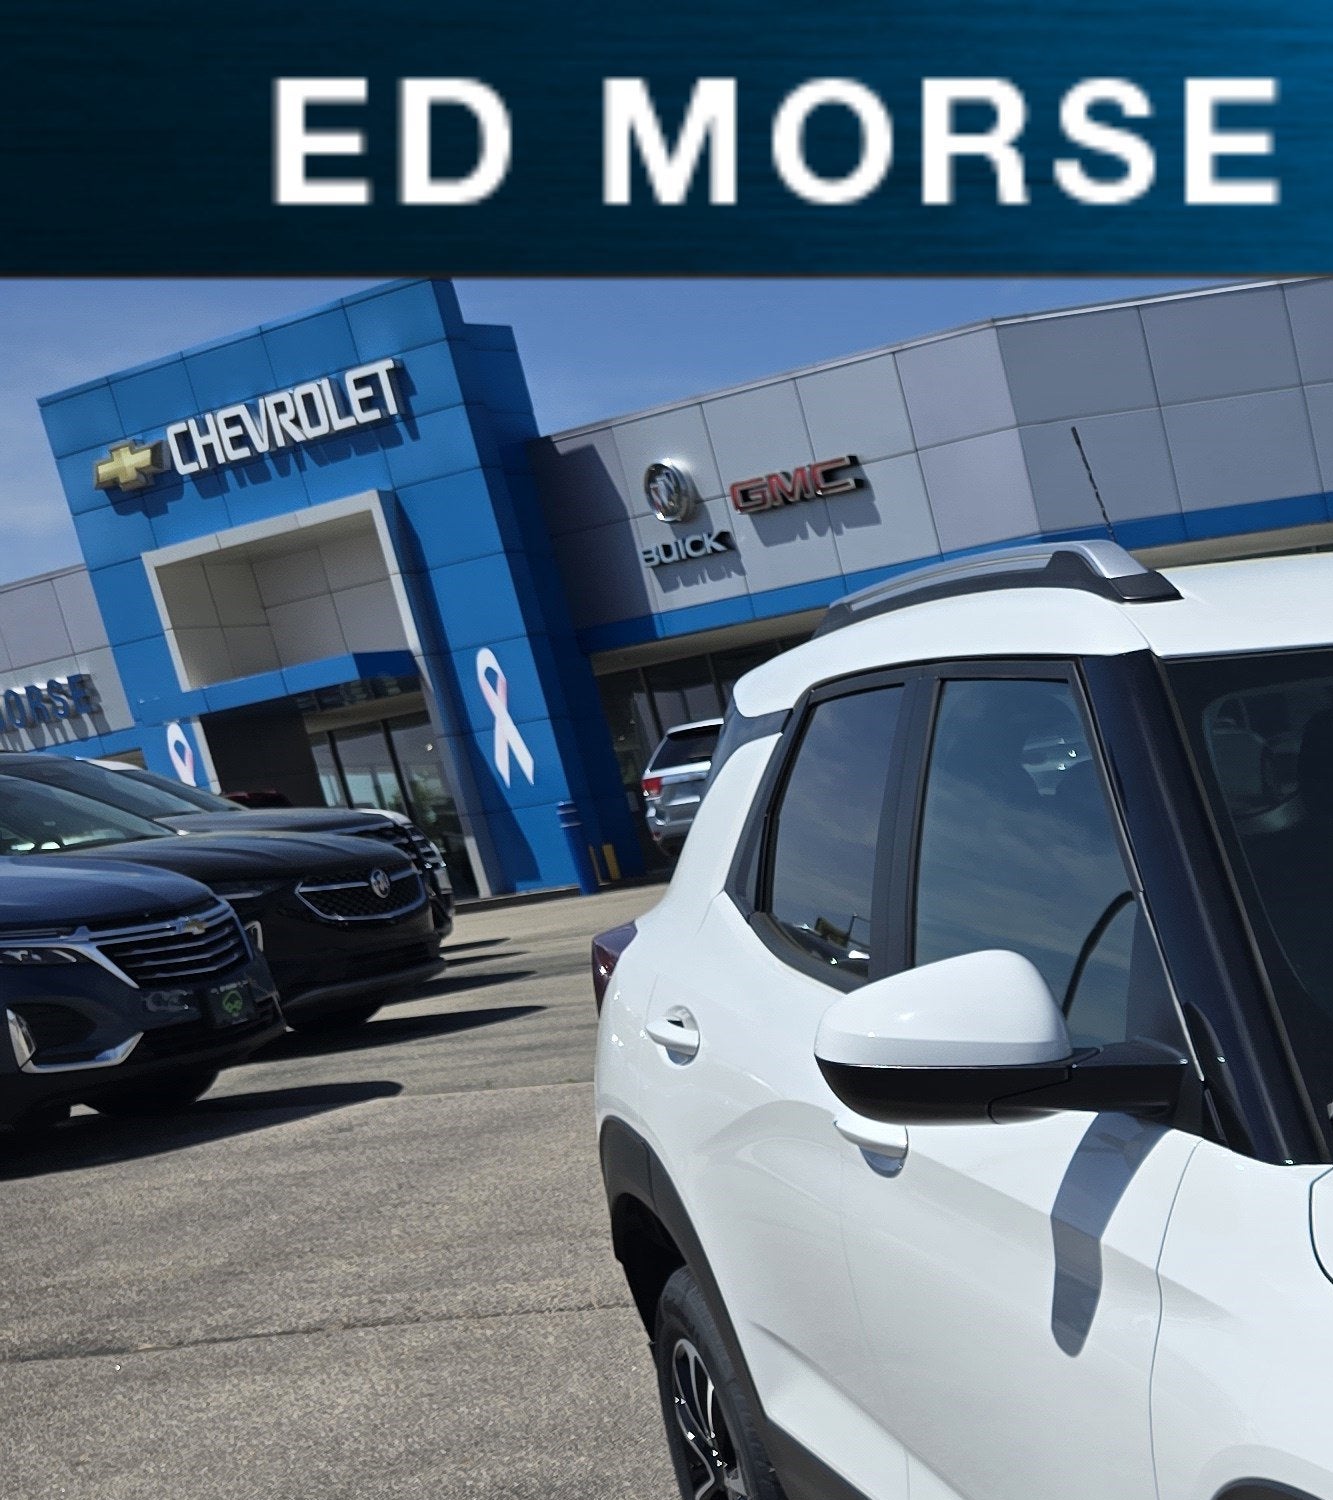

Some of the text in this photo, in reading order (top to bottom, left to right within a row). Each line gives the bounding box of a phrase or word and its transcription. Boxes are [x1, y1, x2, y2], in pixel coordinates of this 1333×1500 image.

[166, 358, 400, 476] CHEVROLET
[730, 455, 859, 514] GMC
[641, 531, 733, 568] BUICK
[0, 673, 98, 732] ORSE
